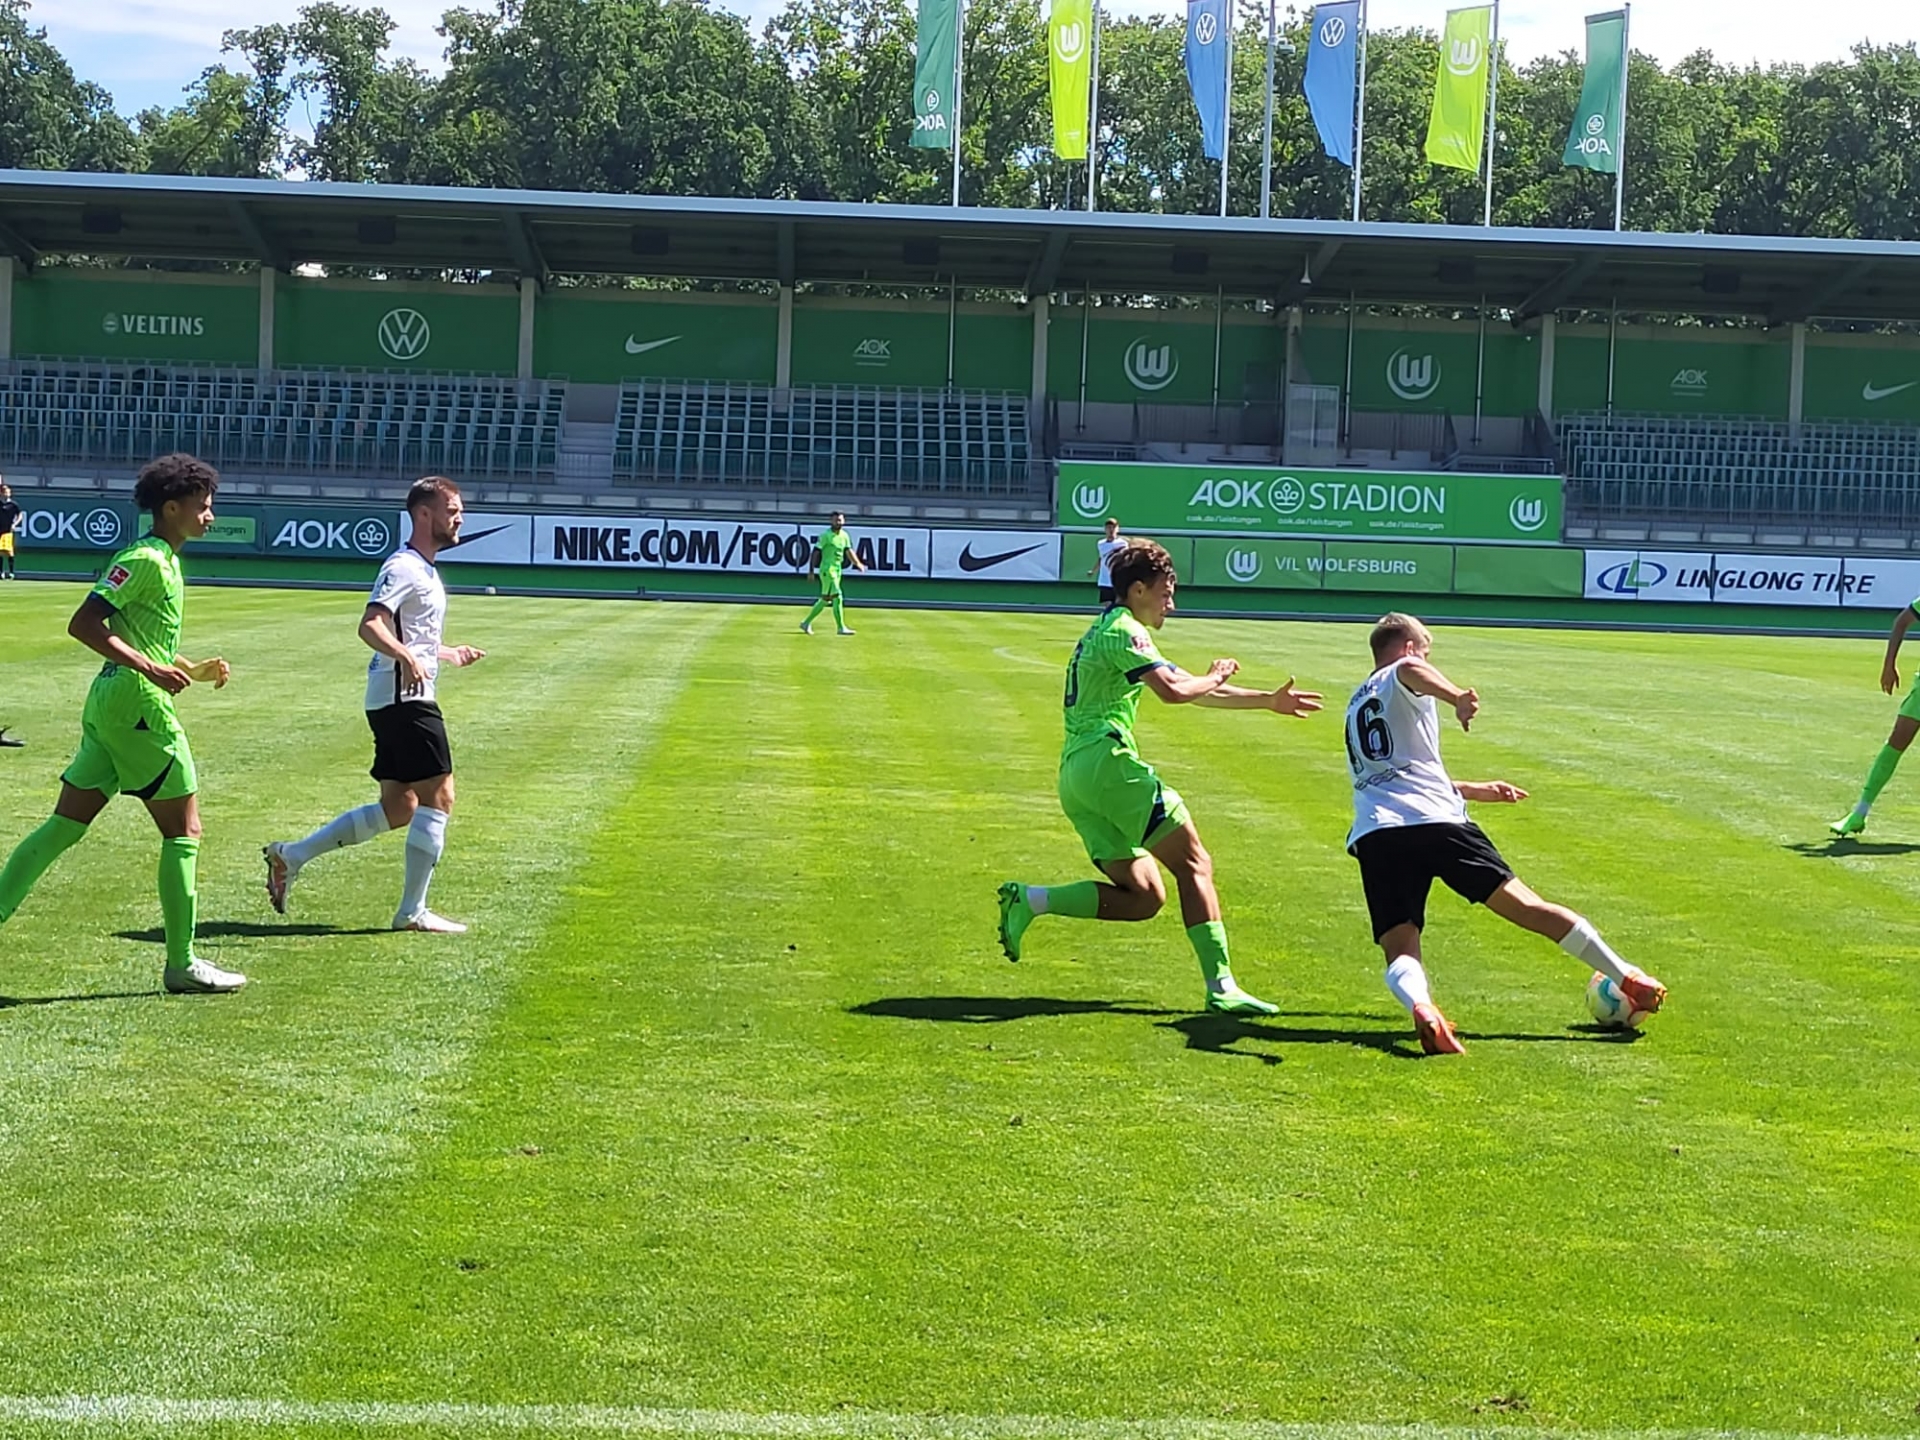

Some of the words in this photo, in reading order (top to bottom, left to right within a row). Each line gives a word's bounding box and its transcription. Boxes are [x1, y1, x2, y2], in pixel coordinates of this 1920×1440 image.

[122, 314, 204, 336] VELTINS
[853, 339, 891, 355] AOK
[1671, 369, 1708, 385] AOK
[1187, 478, 1265, 508] AOK
[1308, 482, 1445, 514] STADION
[271, 520, 350, 549] AOK
[553, 525, 911, 571] NIKE.COM/FOOALL
[1274, 556, 1300, 571] VfL
[1306, 557, 1417, 575] WOLFSBURG
[1675, 568, 1805, 591] LINGLONG
[1812, 572, 1876, 594] TIRE
